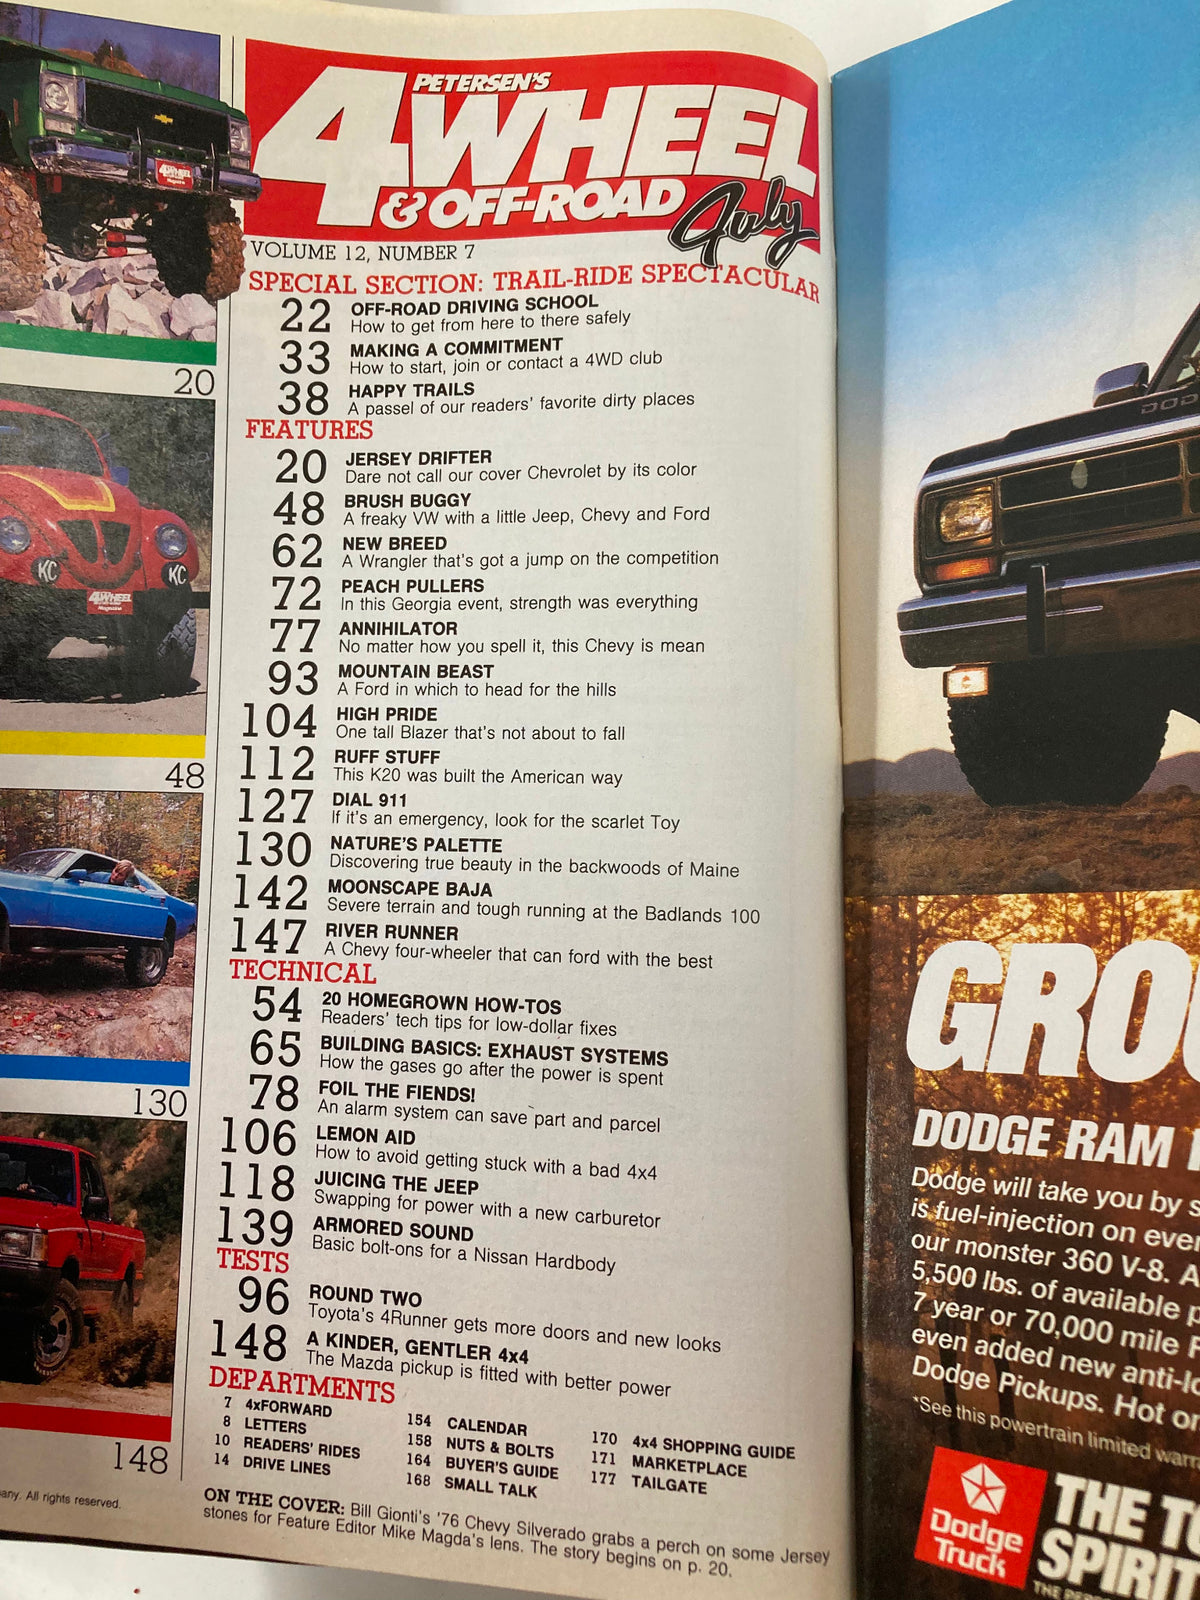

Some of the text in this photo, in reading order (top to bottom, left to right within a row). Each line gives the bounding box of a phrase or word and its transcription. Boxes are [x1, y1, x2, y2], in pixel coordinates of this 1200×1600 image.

[413, 72, 552, 93] PETERSEN'S
[379, 178, 687, 229] & OFF-ROAD
[668, 176, 820, 270] July
[250, 240, 475, 263] VOLUME 12, NUMBER 7
[248, 264, 820, 303] SPECIAL SECTION: TRAIL-RIDE SPECTACULAR
[280, 297, 330, 333] 22
[351, 294, 599, 316] OFF-ROAD DRIVING SCHOOL
[351, 310, 631, 336] How to get from here to there safely
[174, 368, 215, 396] 20
[246, 419, 373, 440] FEATURES
[273, 533, 322, 568] 62
[343, 536, 447, 550] NEW BREED
[38, 559, 57, 582] KC
[168, 565, 187, 585] KC
[342, 550, 718, 571] A Wrangler that's got a jump on the competition
[165, 763, 204, 788] 48
[234, 874, 307, 910] 142
[328, 879, 492, 897] MOONSCAPE BAJA
[328, 897, 760, 924] Severe terrain and tough running at the Badlands 100
[229, 959, 377, 984] TECHNICAL
[906, 940, 1200, 1083] GRO
[134, 1088, 187, 1118] 130
[912, 1108, 1055, 1158] DODGE
[1063, 1119, 1175, 1168] RAM
[911, 1166, 986, 1195] Dodge
[993, 1177, 1032, 1198] will
[1038, 1180, 1088, 1204] take
[1094, 1189, 1143, 1211] you
[1149, 1190, 1181, 1217] by
[911, 1198, 1136, 1244] is fuel-injection on
[217, 1247, 289, 1273] TESTS
[911, 1234, 950, 1252] our
[955, 1239, 1056, 1267] monster
[1062, 1248, 1113, 1275] 360
[1121, 1254, 1171, 1283] V-8.
[912, 1259, 977, 1289] 5,500
[983, 1270, 1022, 1295] lbs.
[1031, 1278, 1058, 1300] of
[1062, 1287, 1181, 1321] available
[912, 1291, 927, 1312] 7
[931, 1297, 984, 1323] year
[990, 1309, 1017, 1327] or
[1024, 1309, 1114, 1344] 70,000
[1120, 1328, 1180, 1356] mile
[912, 1328, 1116, 1379] even added new
[209, 1366, 395, 1404] DEPARTMENTS
[912, 1355, 1164, 1425] Dodge Pickups. Hot
[224, 1396, 332, 1417] 7 4xFORWARD
[408, 1413, 527, 1436] 154 CALENDAR
[956, 1403, 986, 1425] this
[990, 1413, 1084, 1447] powertrain
[1088, 1432, 1151, 1460] limited
[113, 1442, 169, 1474] 148
[216, 1434, 360, 1459] 10 READERS' RIDES
[408, 1433, 554, 1459] 158 NUTS & BOLTS
[593, 1431, 795, 1459] 170 4x4 SHOPPING GUIDE
[215, 1453, 331, 1476] 14 DRIVE LINES
[592, 1451, 747, 1478] 171 MARKETPLACE
[26, 1490, 121, 1510] All rights reserved.
[1055, 1472, 1152, 1542] THE
[204, 1488, 829, 1566] ON THE COVER: Bill Gionti's '76 Chevy Silverado grabs a perch on some Jersey
[204, 1506, 732, 1577] stones for Feature Editor Mike Magda's lens. The story begins on p. 20.
[930, 1508, 1024, 1578] Dodge Truck
[1037, 1527, 1200, 1600] SPIRIT
